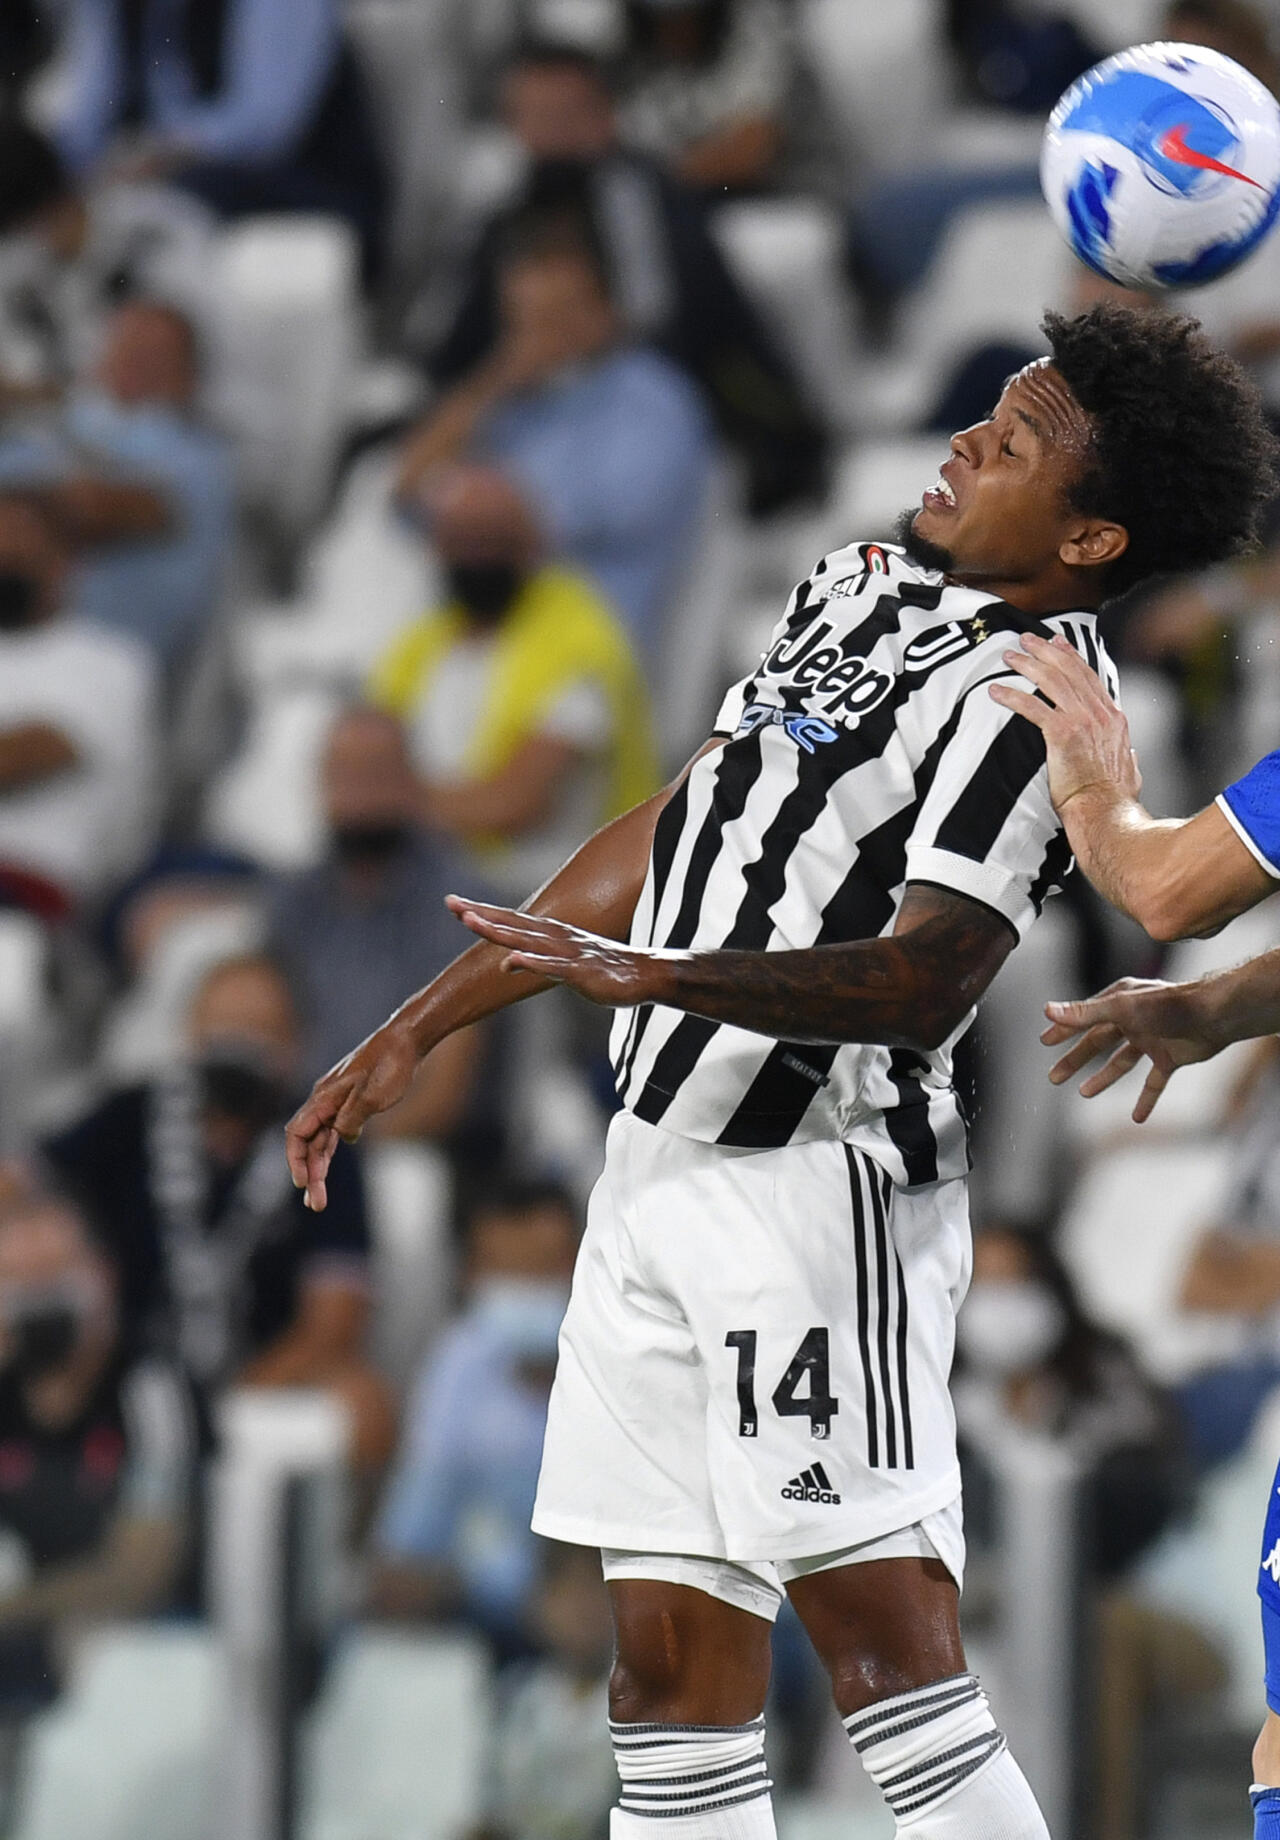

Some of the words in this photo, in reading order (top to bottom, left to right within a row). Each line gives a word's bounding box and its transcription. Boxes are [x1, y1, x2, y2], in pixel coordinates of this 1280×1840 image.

[764, 619, 893, 716] Jeep
[725, 1327, 839, 1440] 14
[780, 1487, 842, 1505] adidas
